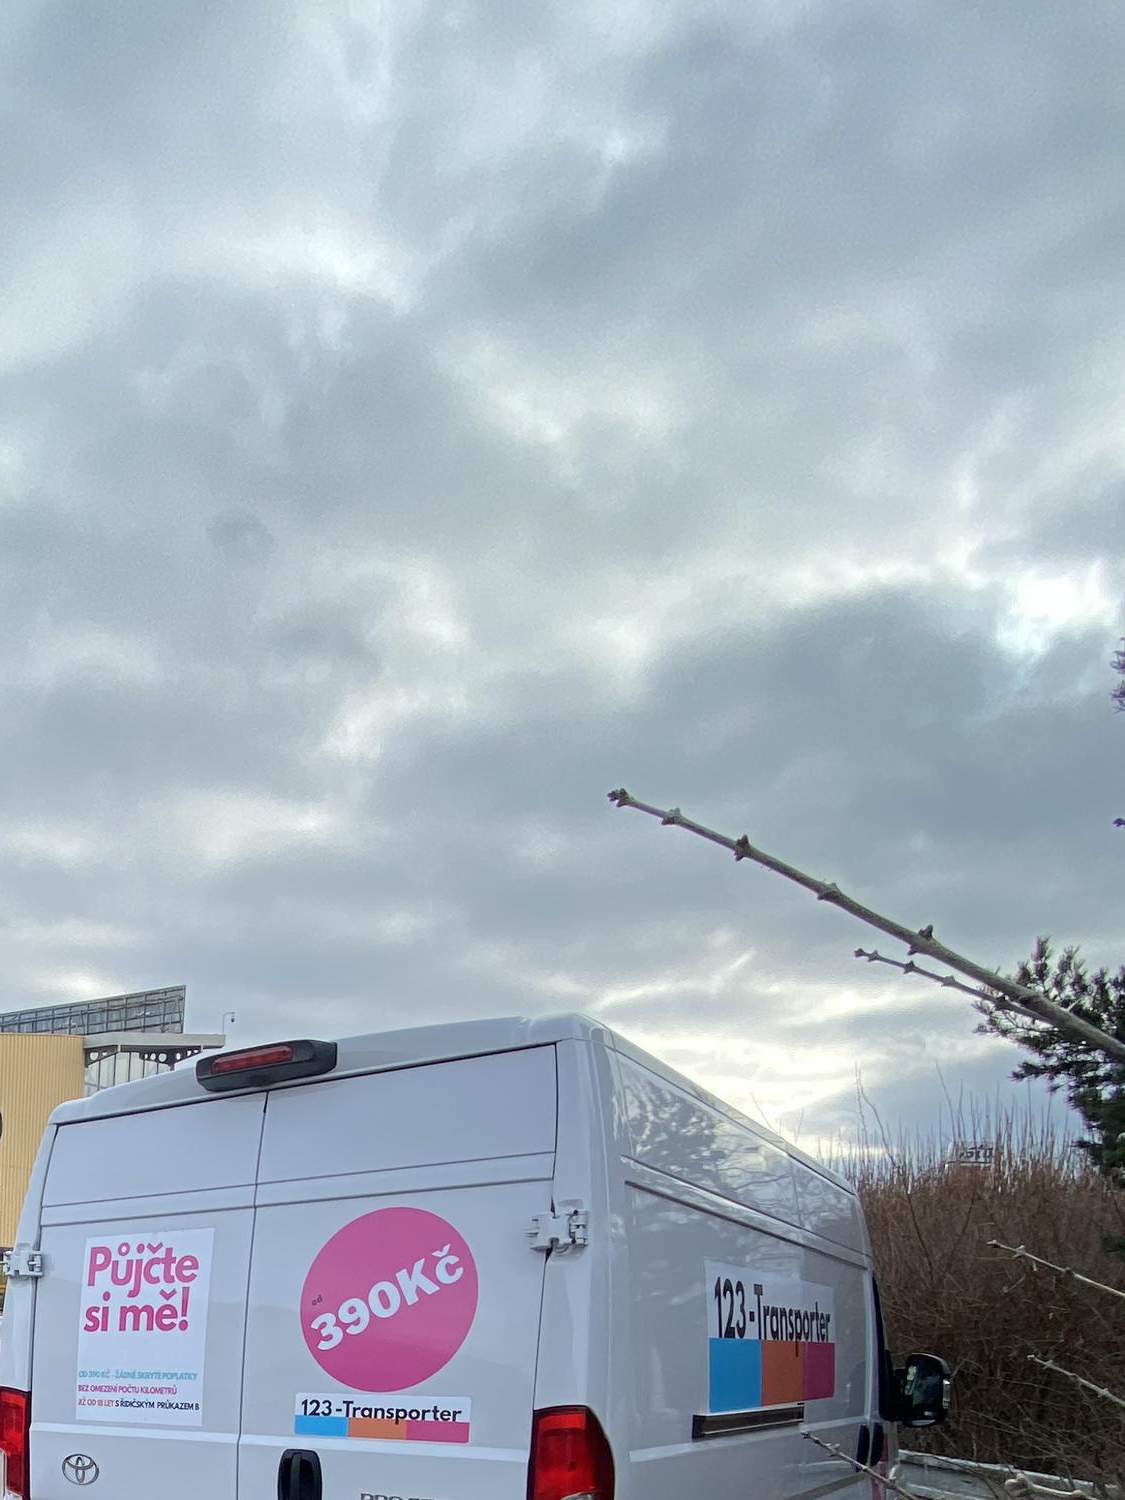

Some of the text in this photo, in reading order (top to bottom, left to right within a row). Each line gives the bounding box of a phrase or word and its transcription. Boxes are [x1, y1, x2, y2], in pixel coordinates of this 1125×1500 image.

[87, 1242, 199, 1298] Půjčte
[84, 1287, 190, 1332] si mě!
[310, 1243, 464, 1350] 390Kč
[78, 1384, 89, 1392] BEZ
[115, 1399, 120, 1407] S
[120, 1397, 155, 1409] ŘIDIČSKÝM
[157, 1399, 194, 1410] PRŮKAZEM
[195, 1402, 200, 1410] B
